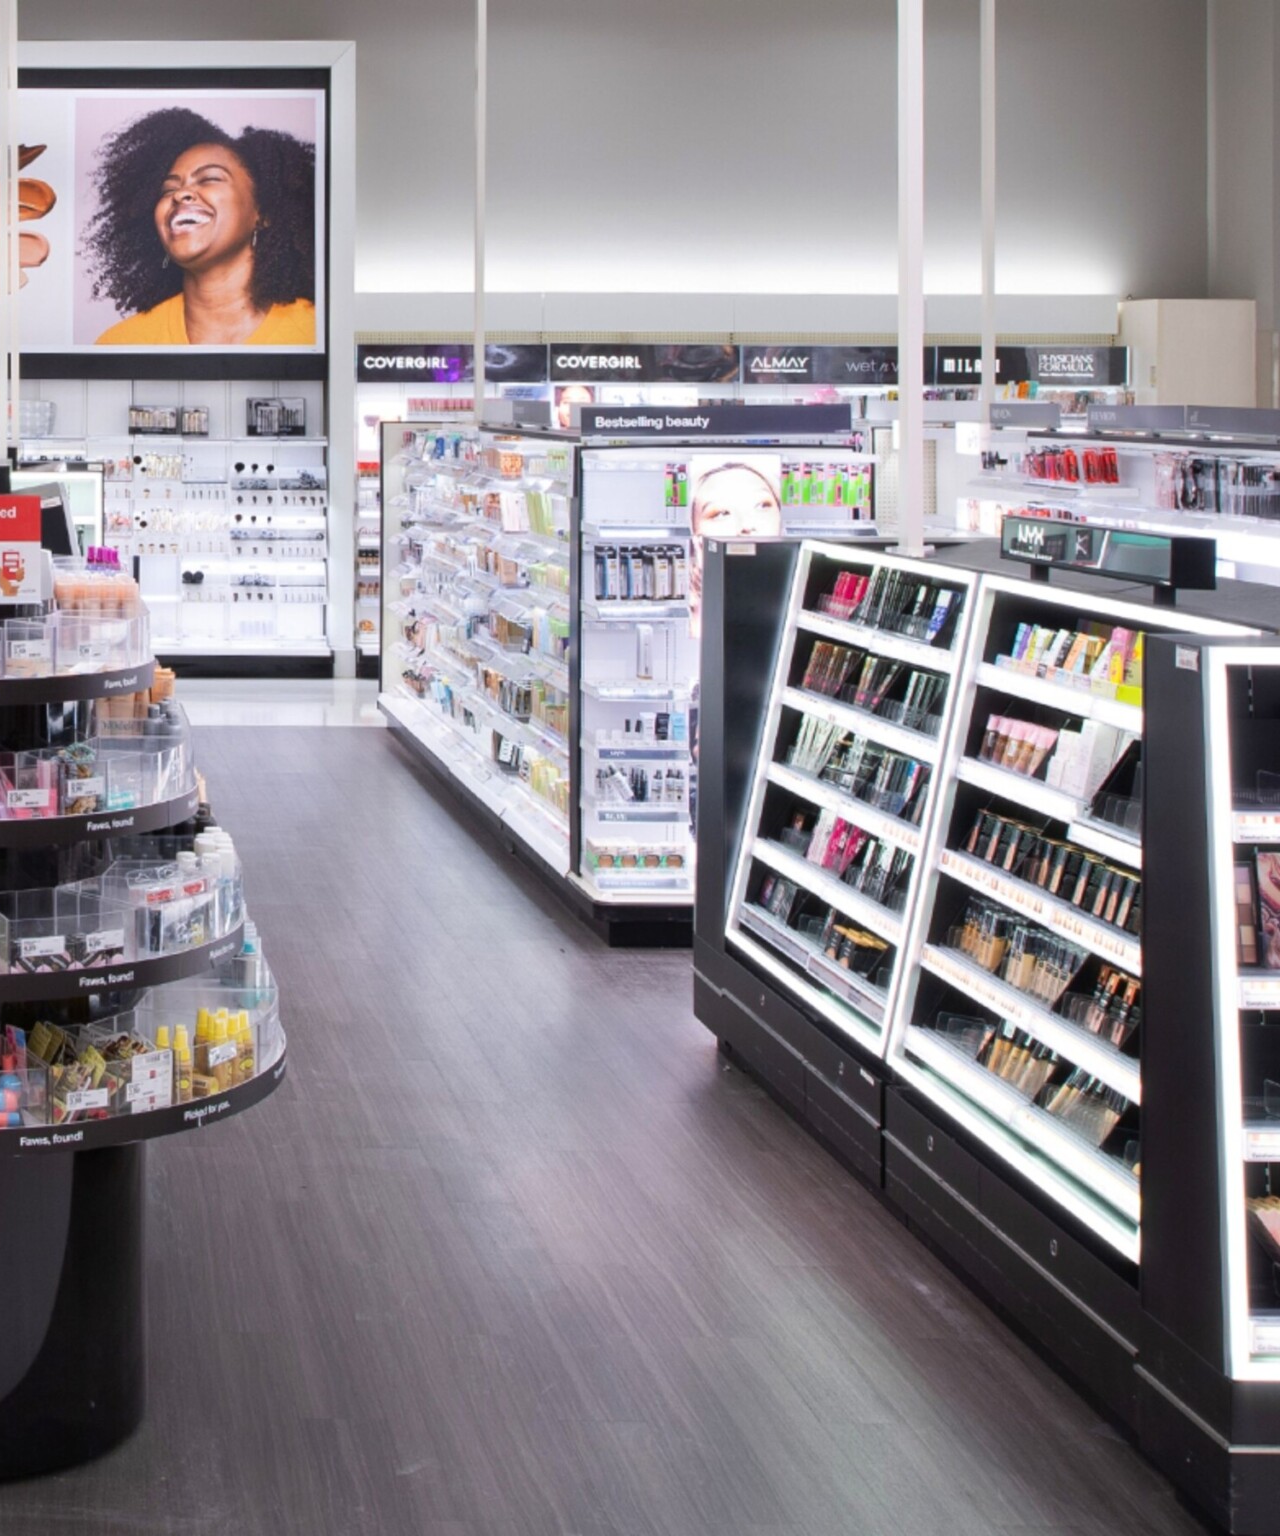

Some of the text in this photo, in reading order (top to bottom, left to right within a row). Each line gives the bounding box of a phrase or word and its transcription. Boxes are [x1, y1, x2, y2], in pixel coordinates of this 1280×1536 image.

[363, 355, 448, 369] COVERGIRL
[556, 355, 641, 369] COVERGIRL
[751, 357, 809, 368] ALMAY
[846, 360, 876, 372] wet
[944, 358, 1000, 373] MILAI
[595, 415, 710, 430] Bestselling beauty
[1018, 524, 1044, 546] NYX
[108, 970, 135, 984] found!
[20, 1131, 83, 1148] Faves, found!
